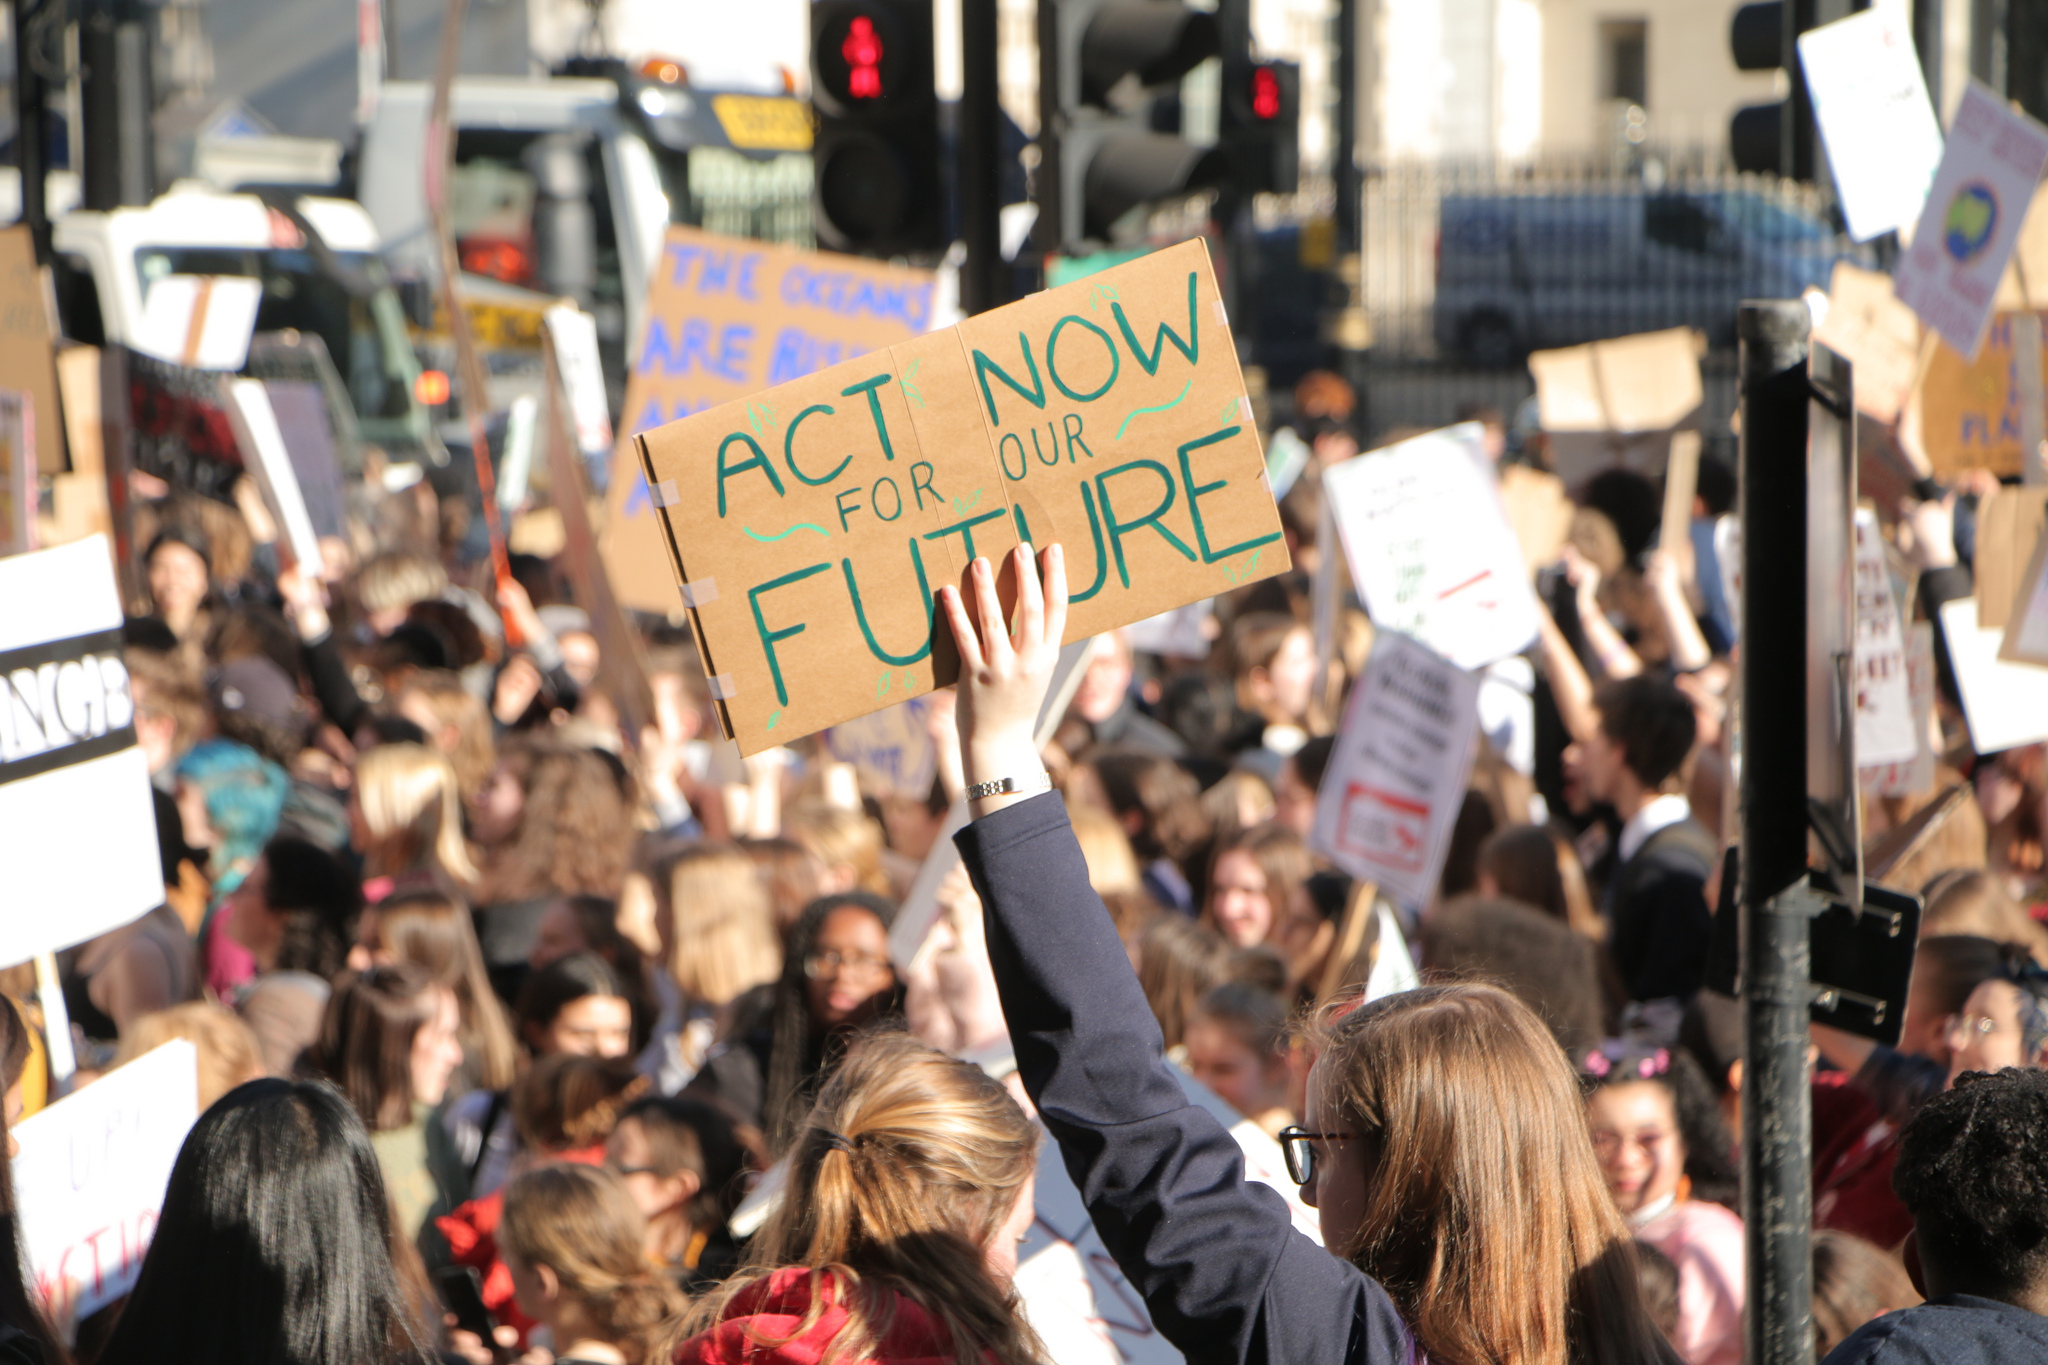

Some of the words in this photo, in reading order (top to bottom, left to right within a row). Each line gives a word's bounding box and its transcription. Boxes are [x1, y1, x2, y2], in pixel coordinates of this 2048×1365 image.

[666, 243, 767, 304] THE
[778, 263, 936, 333] OCEANS
[635, 316, 755, 386] ARE
[716, 373, 892, 518] ACT
[972, 272, 1197, 427] NOW
[834, 460, 945, 533] FOR
[999, 413, 1093, 481] OUR
[0, 653, 132, 758] NGE
